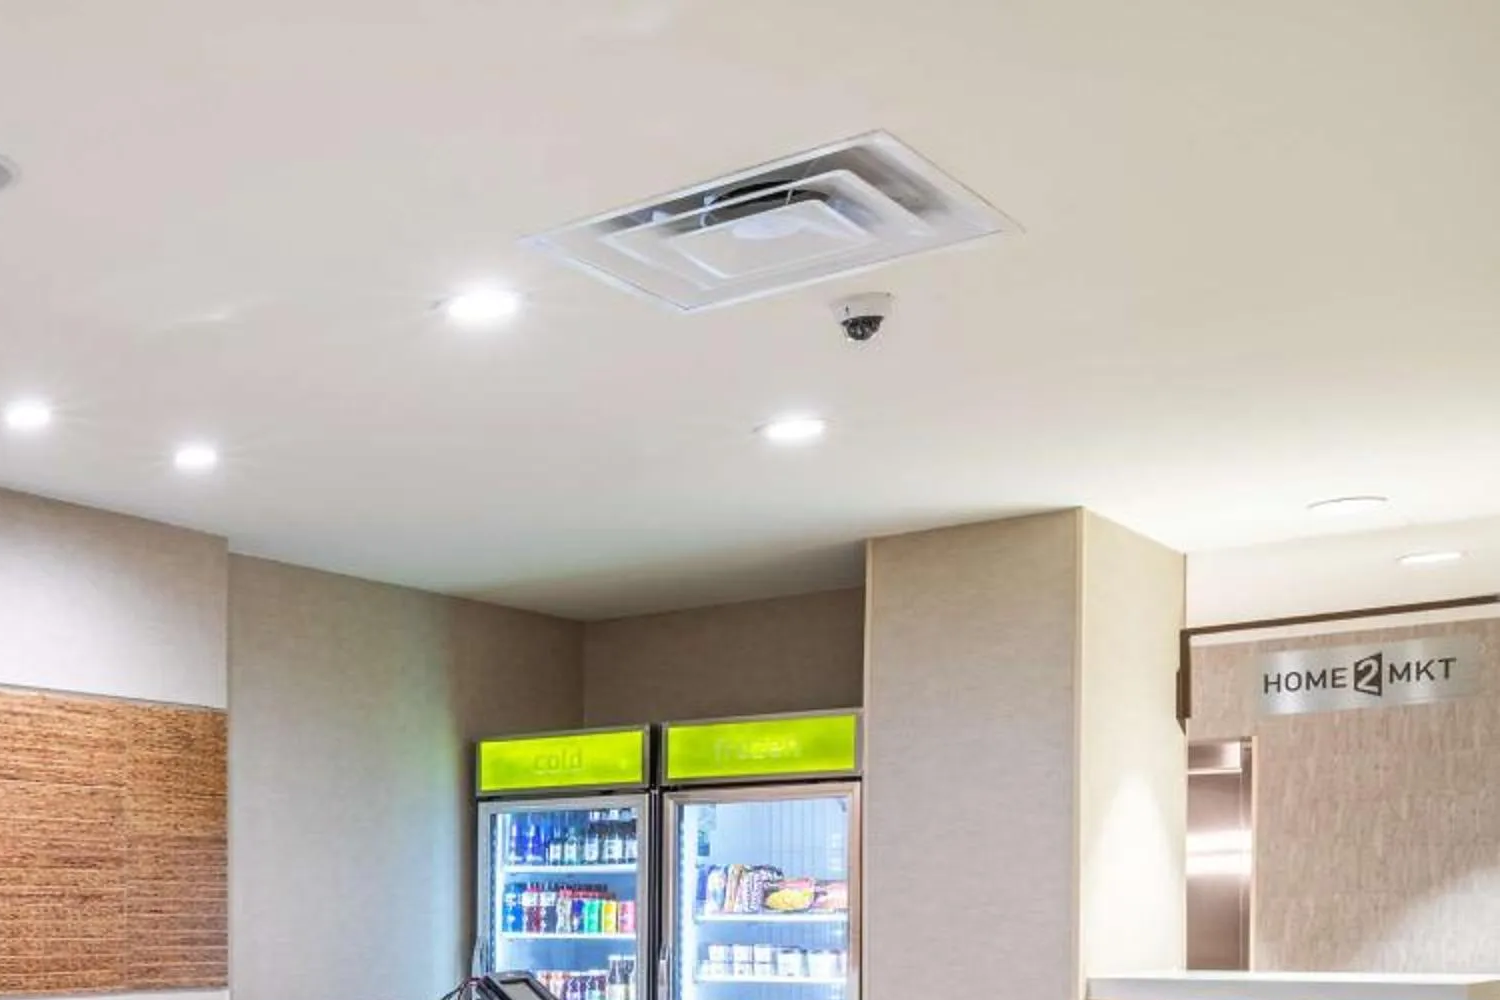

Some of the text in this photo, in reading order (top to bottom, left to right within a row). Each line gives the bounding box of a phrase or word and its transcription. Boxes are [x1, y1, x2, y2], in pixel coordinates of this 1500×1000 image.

[1263, 667, 1349, 694] HOME
[1389, 657, 1457, 684] MKT
[533, 747, 583, 772] cold
